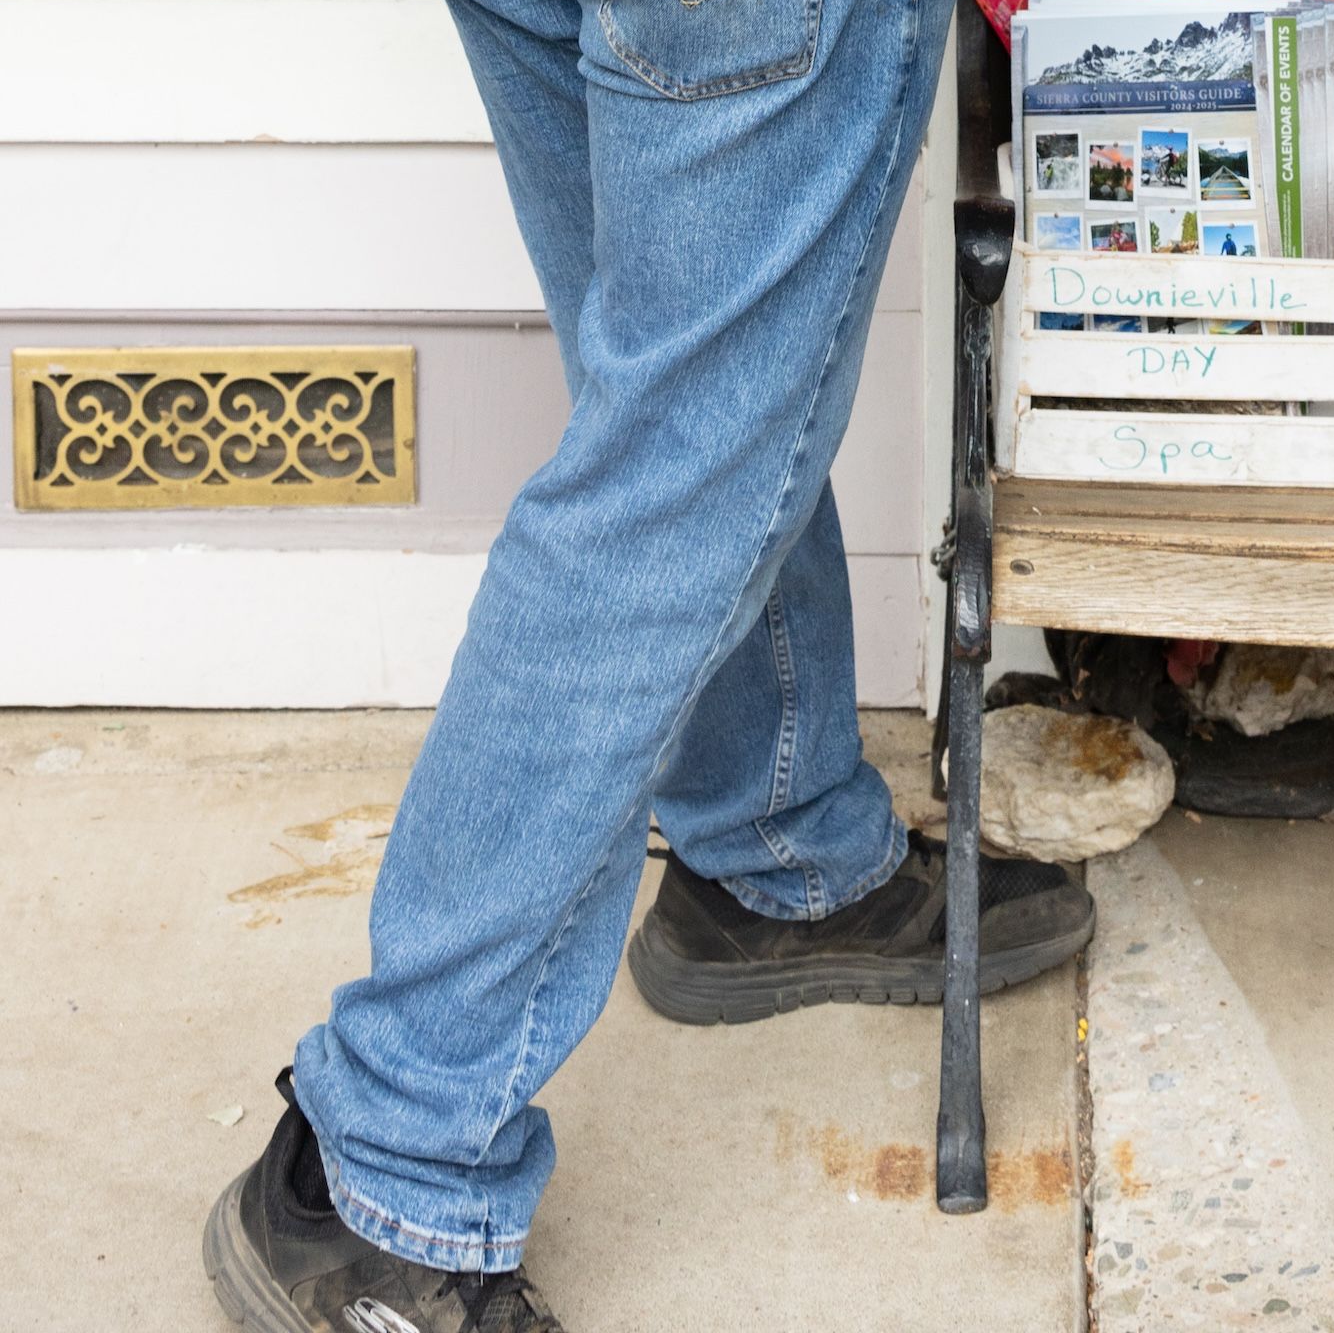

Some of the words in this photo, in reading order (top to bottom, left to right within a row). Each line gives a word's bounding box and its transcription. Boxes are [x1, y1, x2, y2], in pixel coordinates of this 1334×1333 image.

[1278, 25, 1291, 79] EVENTS
[1036, 92, 1079, 105] SIERRA
[1082, 90, 1133, 104] COUNTY
[1135, 88, 1195, 102] VISITORS
[1199, 88, 1242, 101] GUIDE
[1170, 101, 1217, 112] 2024-2025
[1281, 81, 1292, 104] OF
[1282, 106, 1294, 183] CALENDAR
[1044, 266, 1307, 310] Downieville
[1127, 345, 1217, 377] DAY
[1098, 425, 1233, 474] Spa
